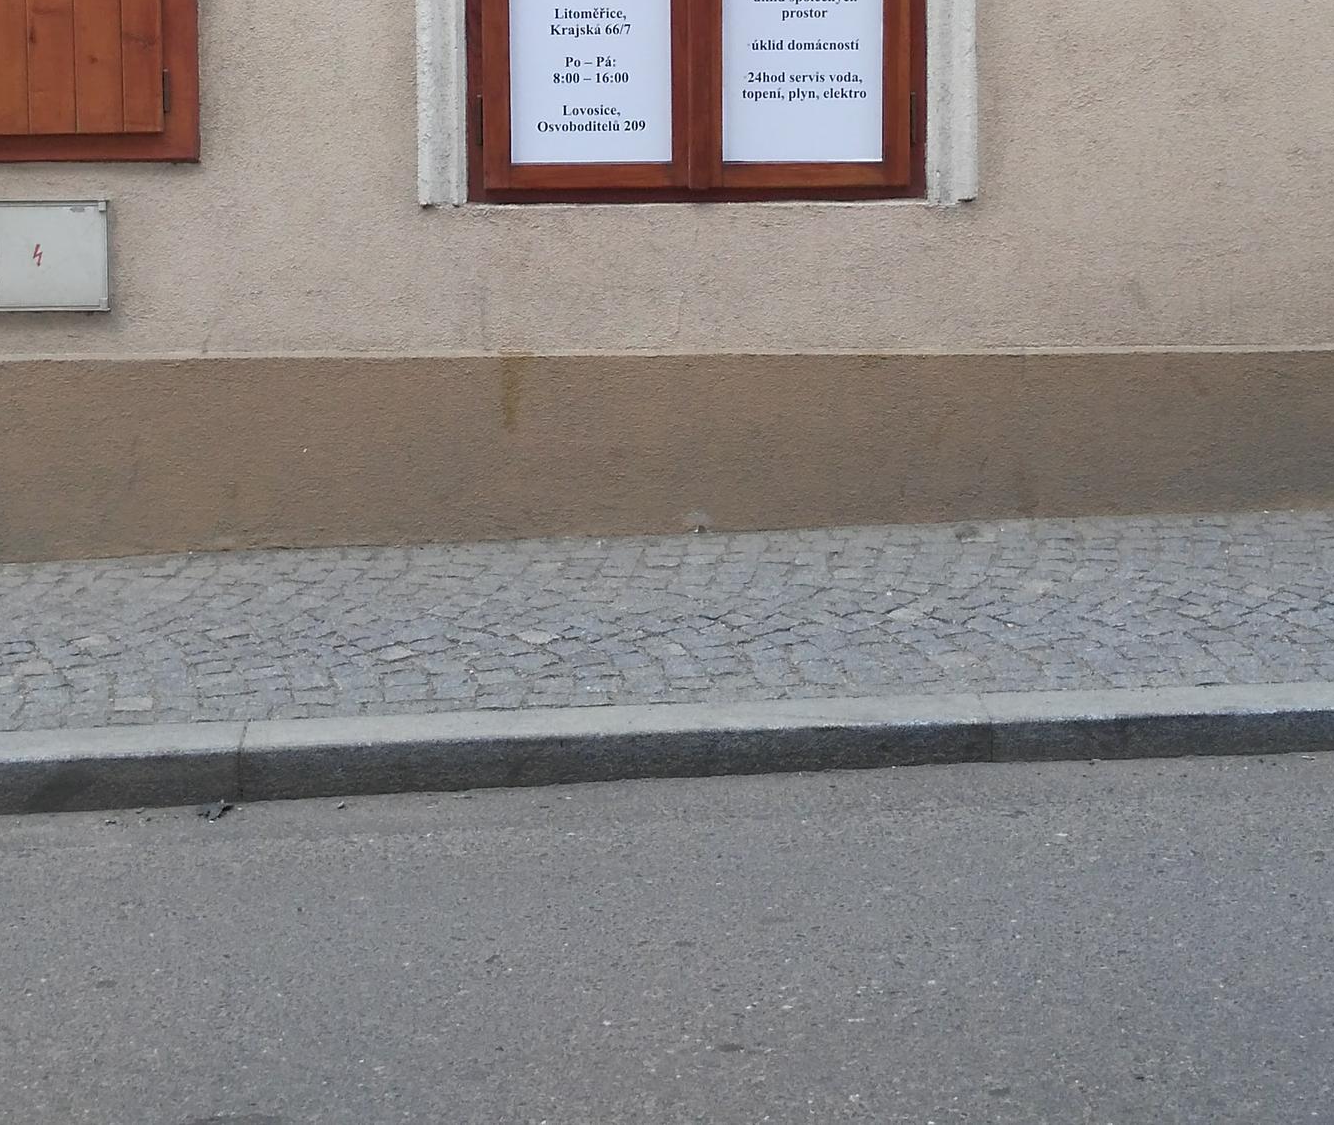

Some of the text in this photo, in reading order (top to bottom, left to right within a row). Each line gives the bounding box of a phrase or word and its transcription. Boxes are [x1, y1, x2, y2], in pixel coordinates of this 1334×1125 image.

[555, 8, 626, 20] Litoměřice,
[782, 8, 827, 21] prostor
[551, 24, 630, 38] Krajská 66/7
[788, 39, 859, 50] domácností
[566, 57, 580, 67] Po
[597, 56, 615, 67] Pá:
[553, 73, 579, 83] 8:00
[596, 72, 628, 83] 16:00
[790, 72, 825, 82] servis
[829, 72, 862, 83] voda,
[743, 88, 866, 101] topení, plyn, elektro
[563, 105, 620, 116] Lovosice,
[538, 120, 645, 132] Osvoboditelů 209
